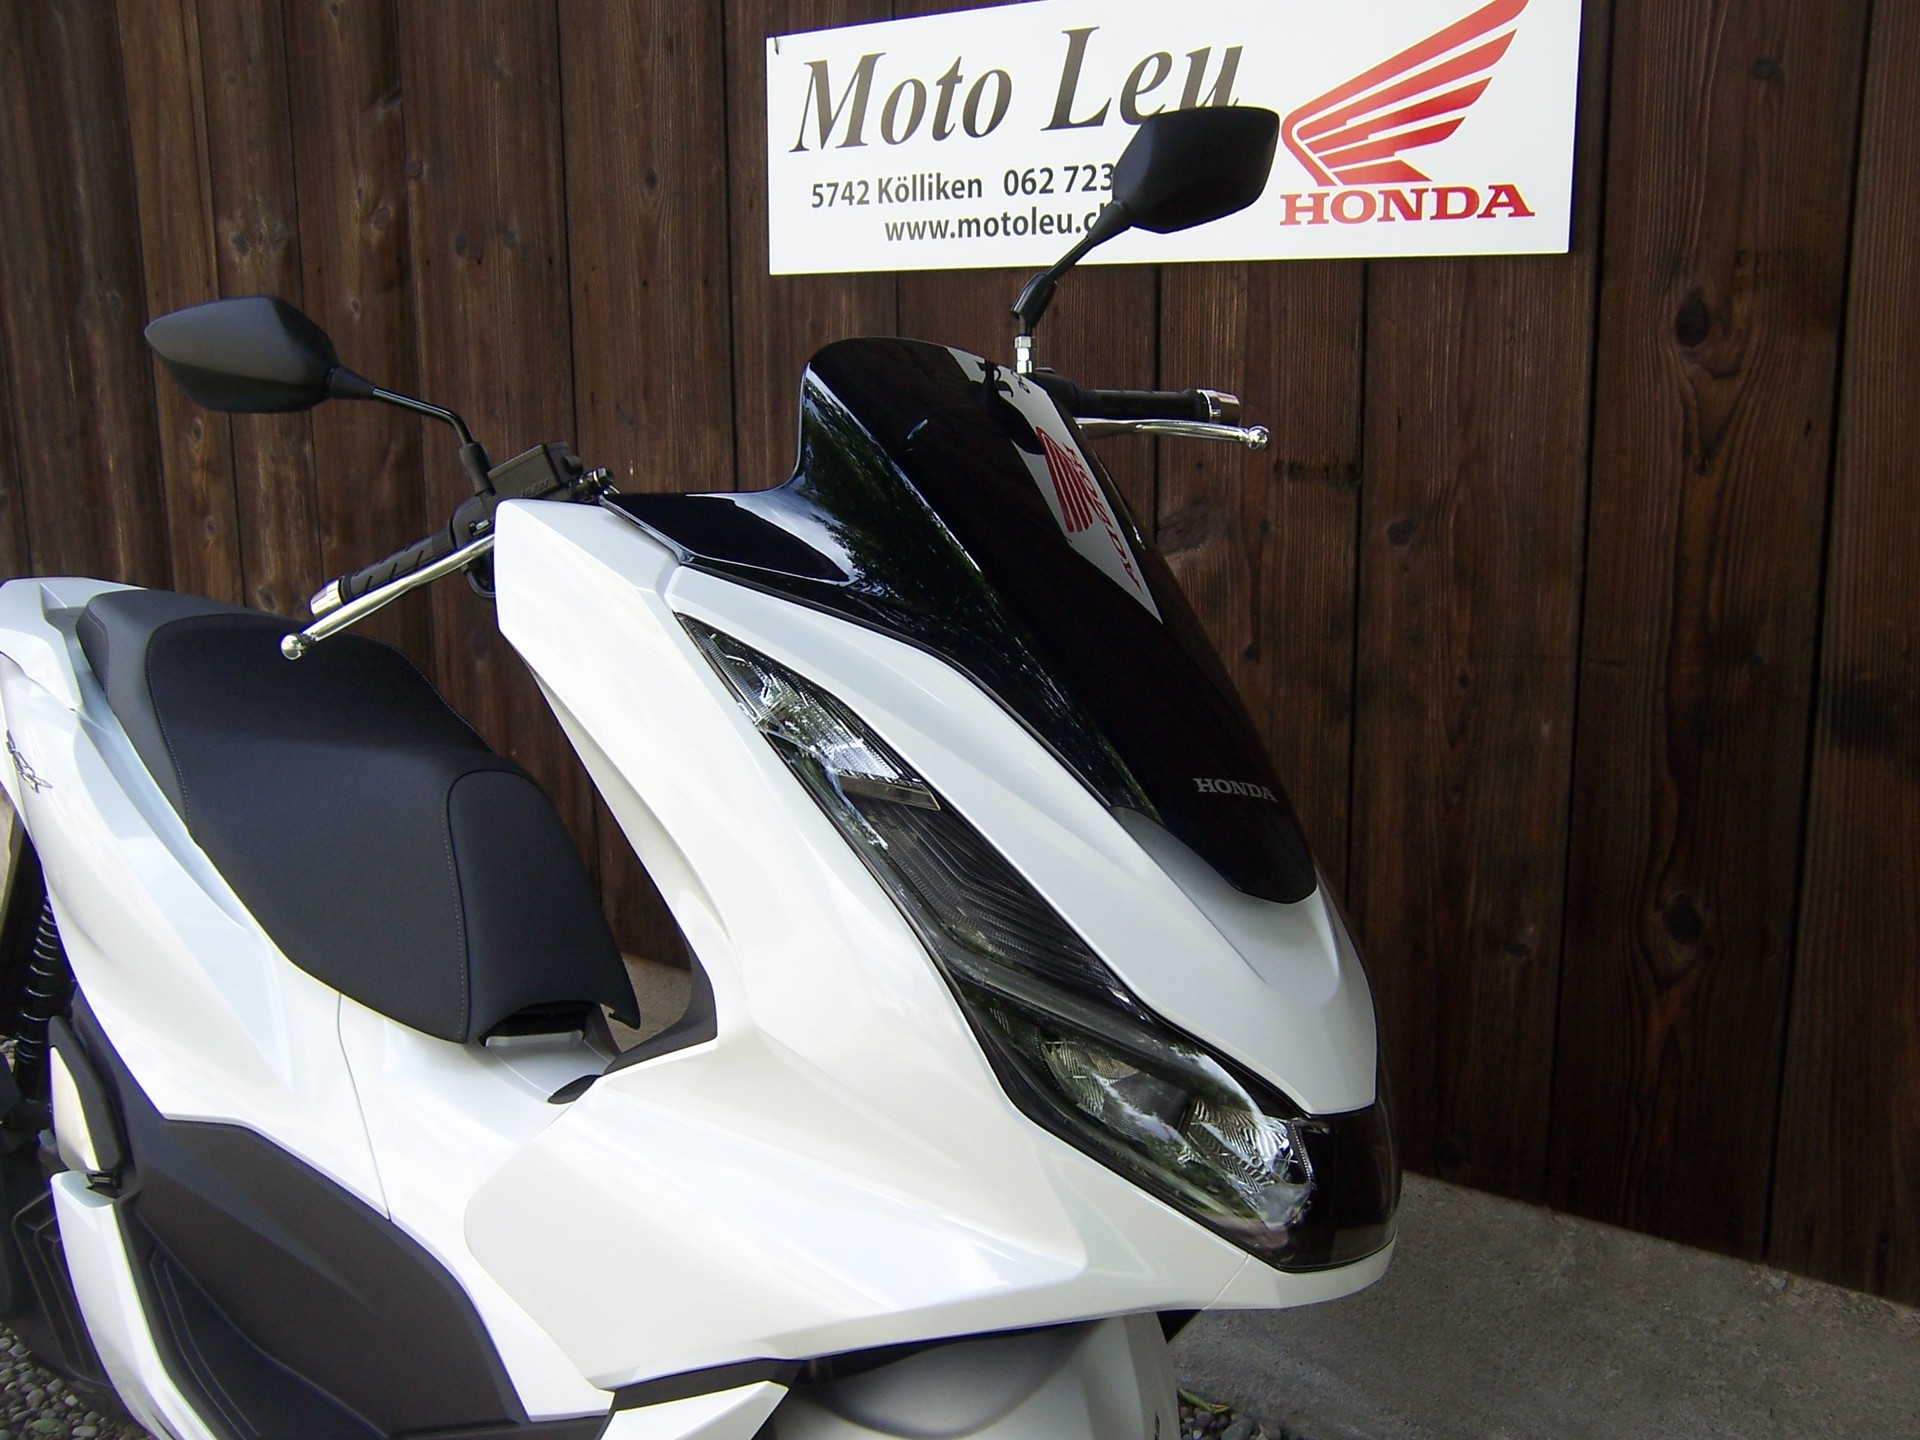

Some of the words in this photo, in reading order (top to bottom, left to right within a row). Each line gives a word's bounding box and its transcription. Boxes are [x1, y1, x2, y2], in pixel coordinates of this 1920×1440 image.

[789, 52, 1012, 152] Moto
[1041, 26, 1244, 131] Leu
[812, 179, 870, 208] 5742
[878, 172, 982, 204] Kölliken
[1003, 167, 1054, 197] 062
[1064, 163, 1114, 193] 723
[1279, 184, 1536, 226] HONDA
[884, 203, 1104, 242] www.motoleu.c
[1193, 778, 1278, 802] HONDA
